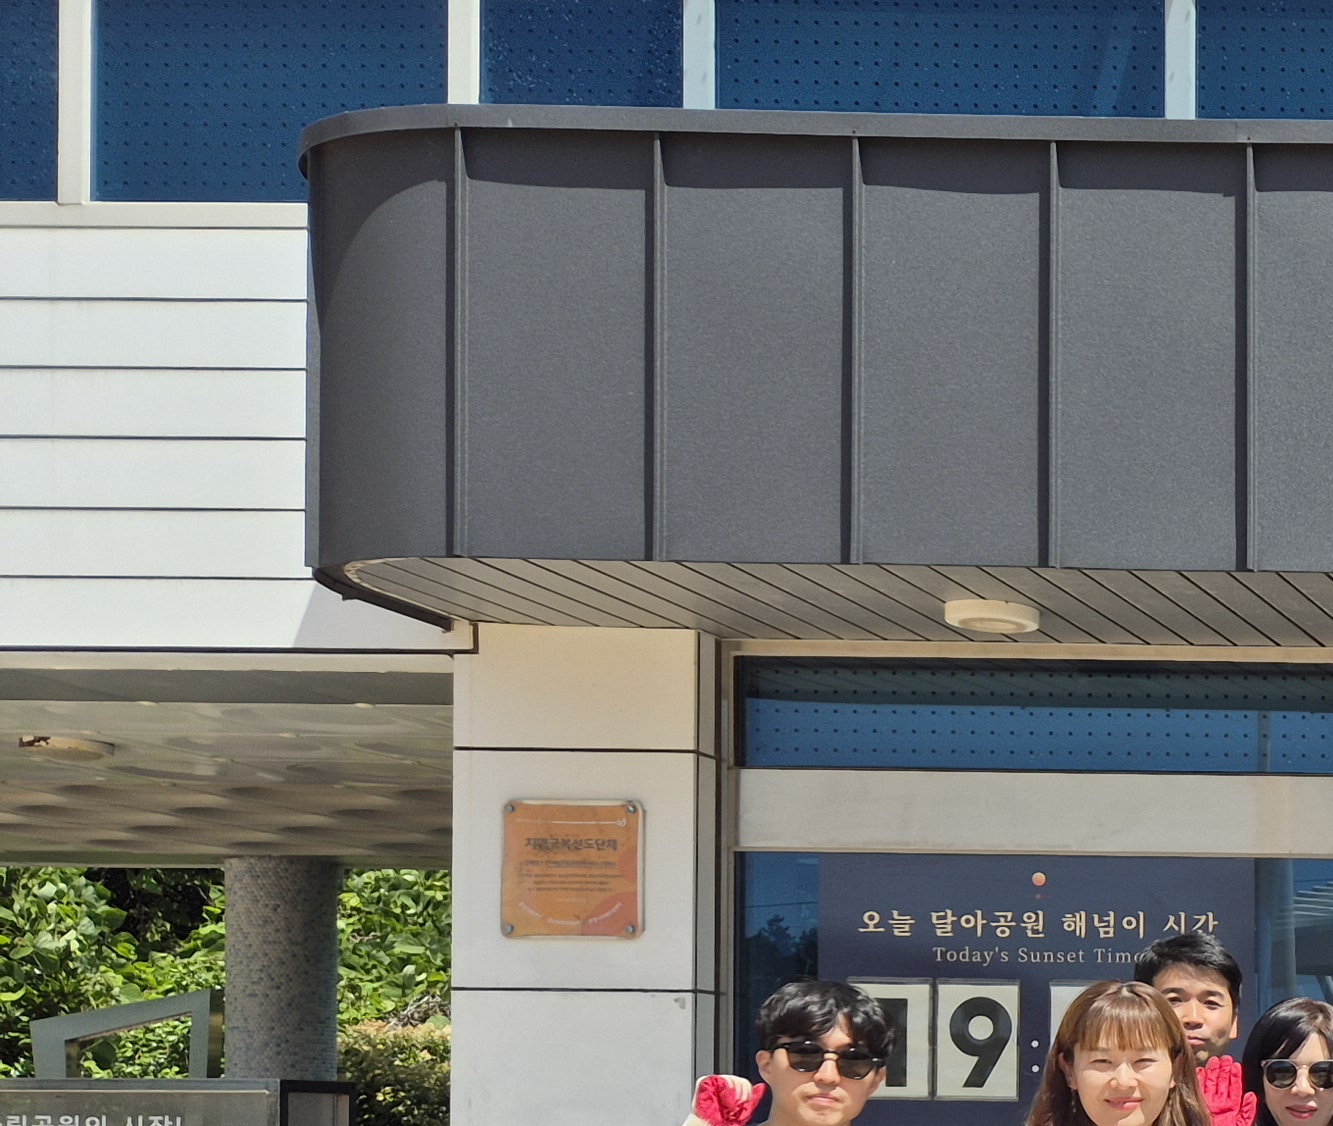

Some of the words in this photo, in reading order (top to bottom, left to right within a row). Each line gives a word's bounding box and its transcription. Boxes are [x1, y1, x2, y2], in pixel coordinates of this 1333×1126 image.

[857, 910, 916, 937] 오늘
[930, 910, 1046, 938] 달아공원
[1061, 911, 1145, 939] 해넘이
[932, 947, 1009, 966] Today's
[1018, 948, 1085, 964] Sunset
